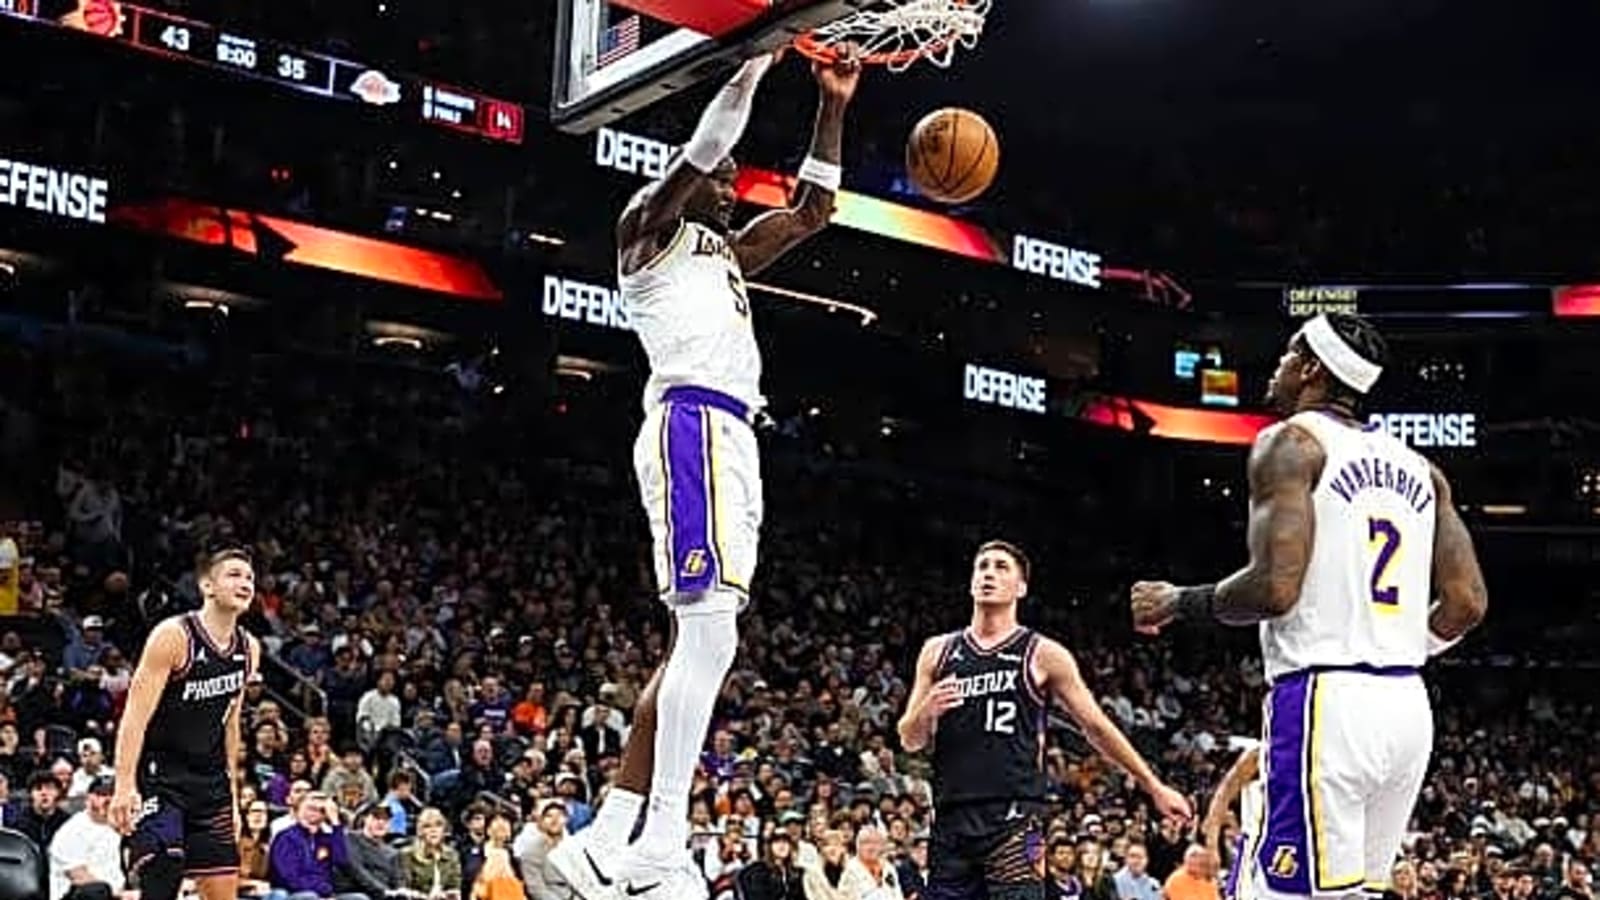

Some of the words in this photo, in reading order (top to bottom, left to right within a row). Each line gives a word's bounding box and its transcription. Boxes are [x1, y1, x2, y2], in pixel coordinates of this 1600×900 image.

[160, 25, 190, 51] 43
[277, 53, 307, 80] 35
[1013, 234, 1101, 288] DEFENSE
[964, 362, 1047, 414] DEFENSE
[1329, 457, 1433, 514] VANDERBILT
[1368, 516, 1402, 606] 2
[984, 698, 1017, 733] 12
